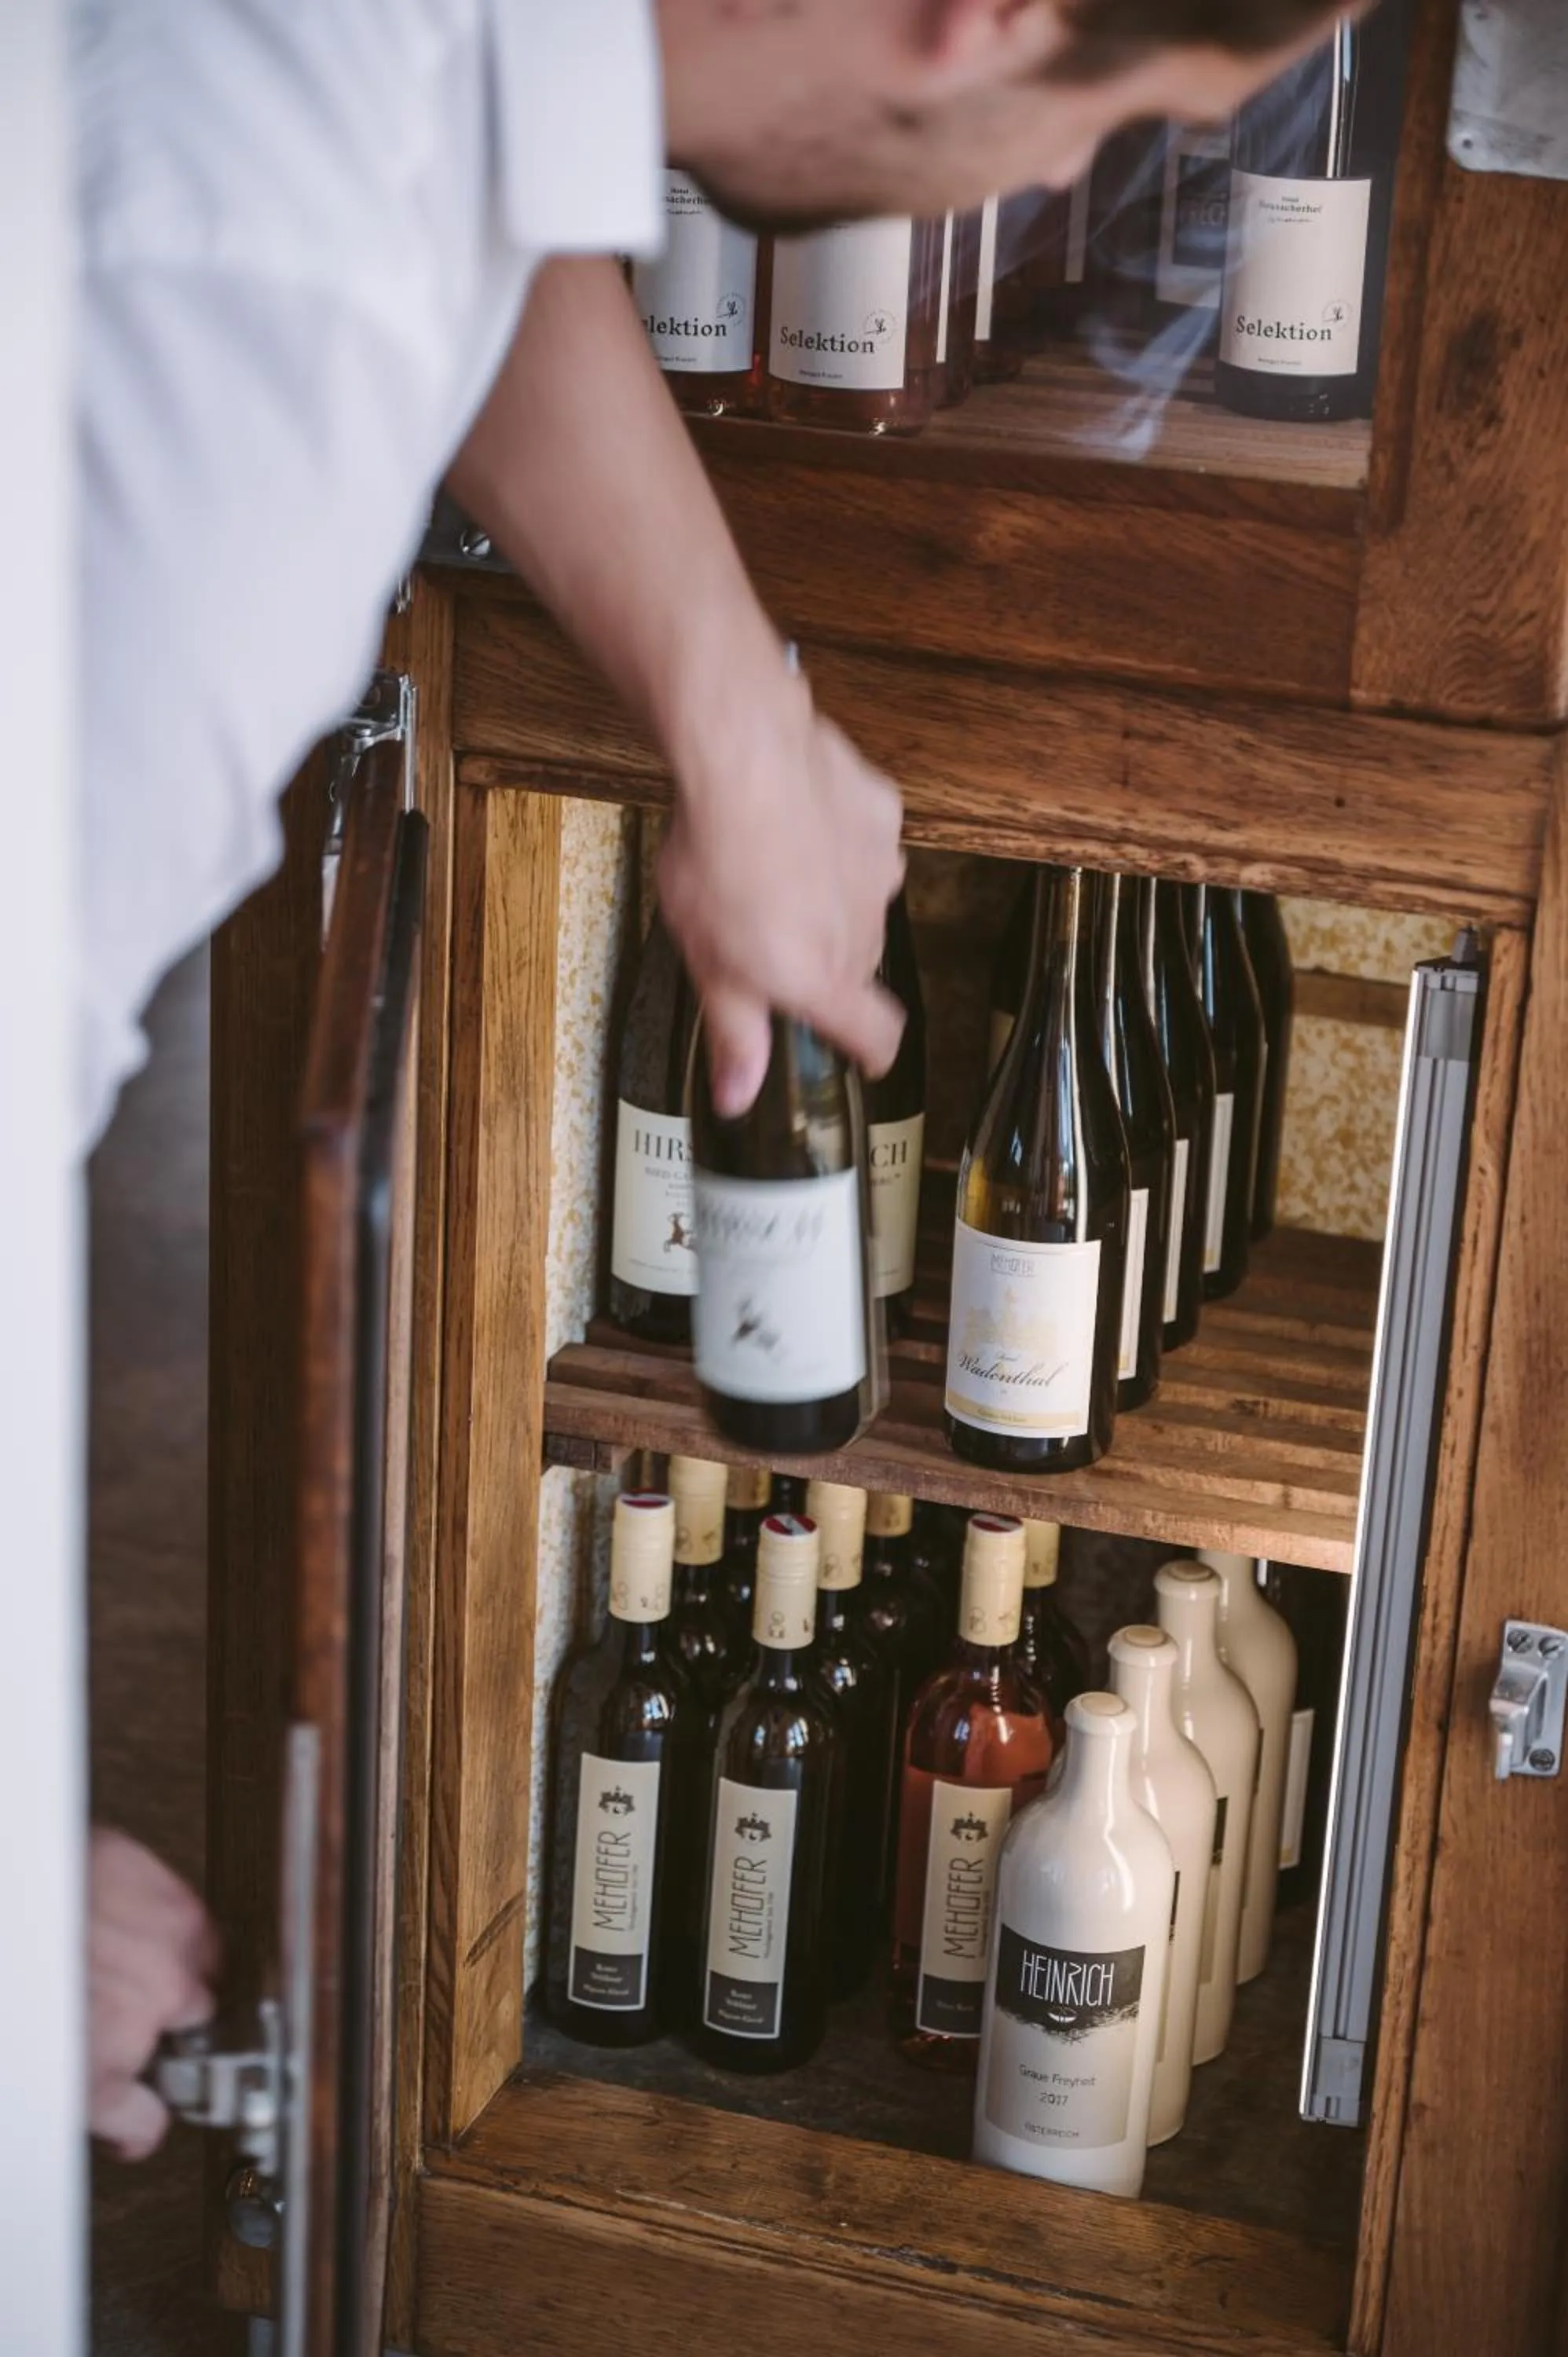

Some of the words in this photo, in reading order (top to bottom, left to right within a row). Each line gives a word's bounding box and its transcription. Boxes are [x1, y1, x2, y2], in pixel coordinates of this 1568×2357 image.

[640, 313, 727, 337] lektion
[780, 325, 876, 354] Selektion
[1235, 313, 1333, 341] Selektion
[633, 1128, 693, 1162] HIR
[592, 1830, 632, 1932] MEHOFER
[727, 1856, 768, 1959] MEHOFER
[943, 1857, 984, 1959] MEHOFER
[1020, 1948, 1115, 2007] HEINRICH
